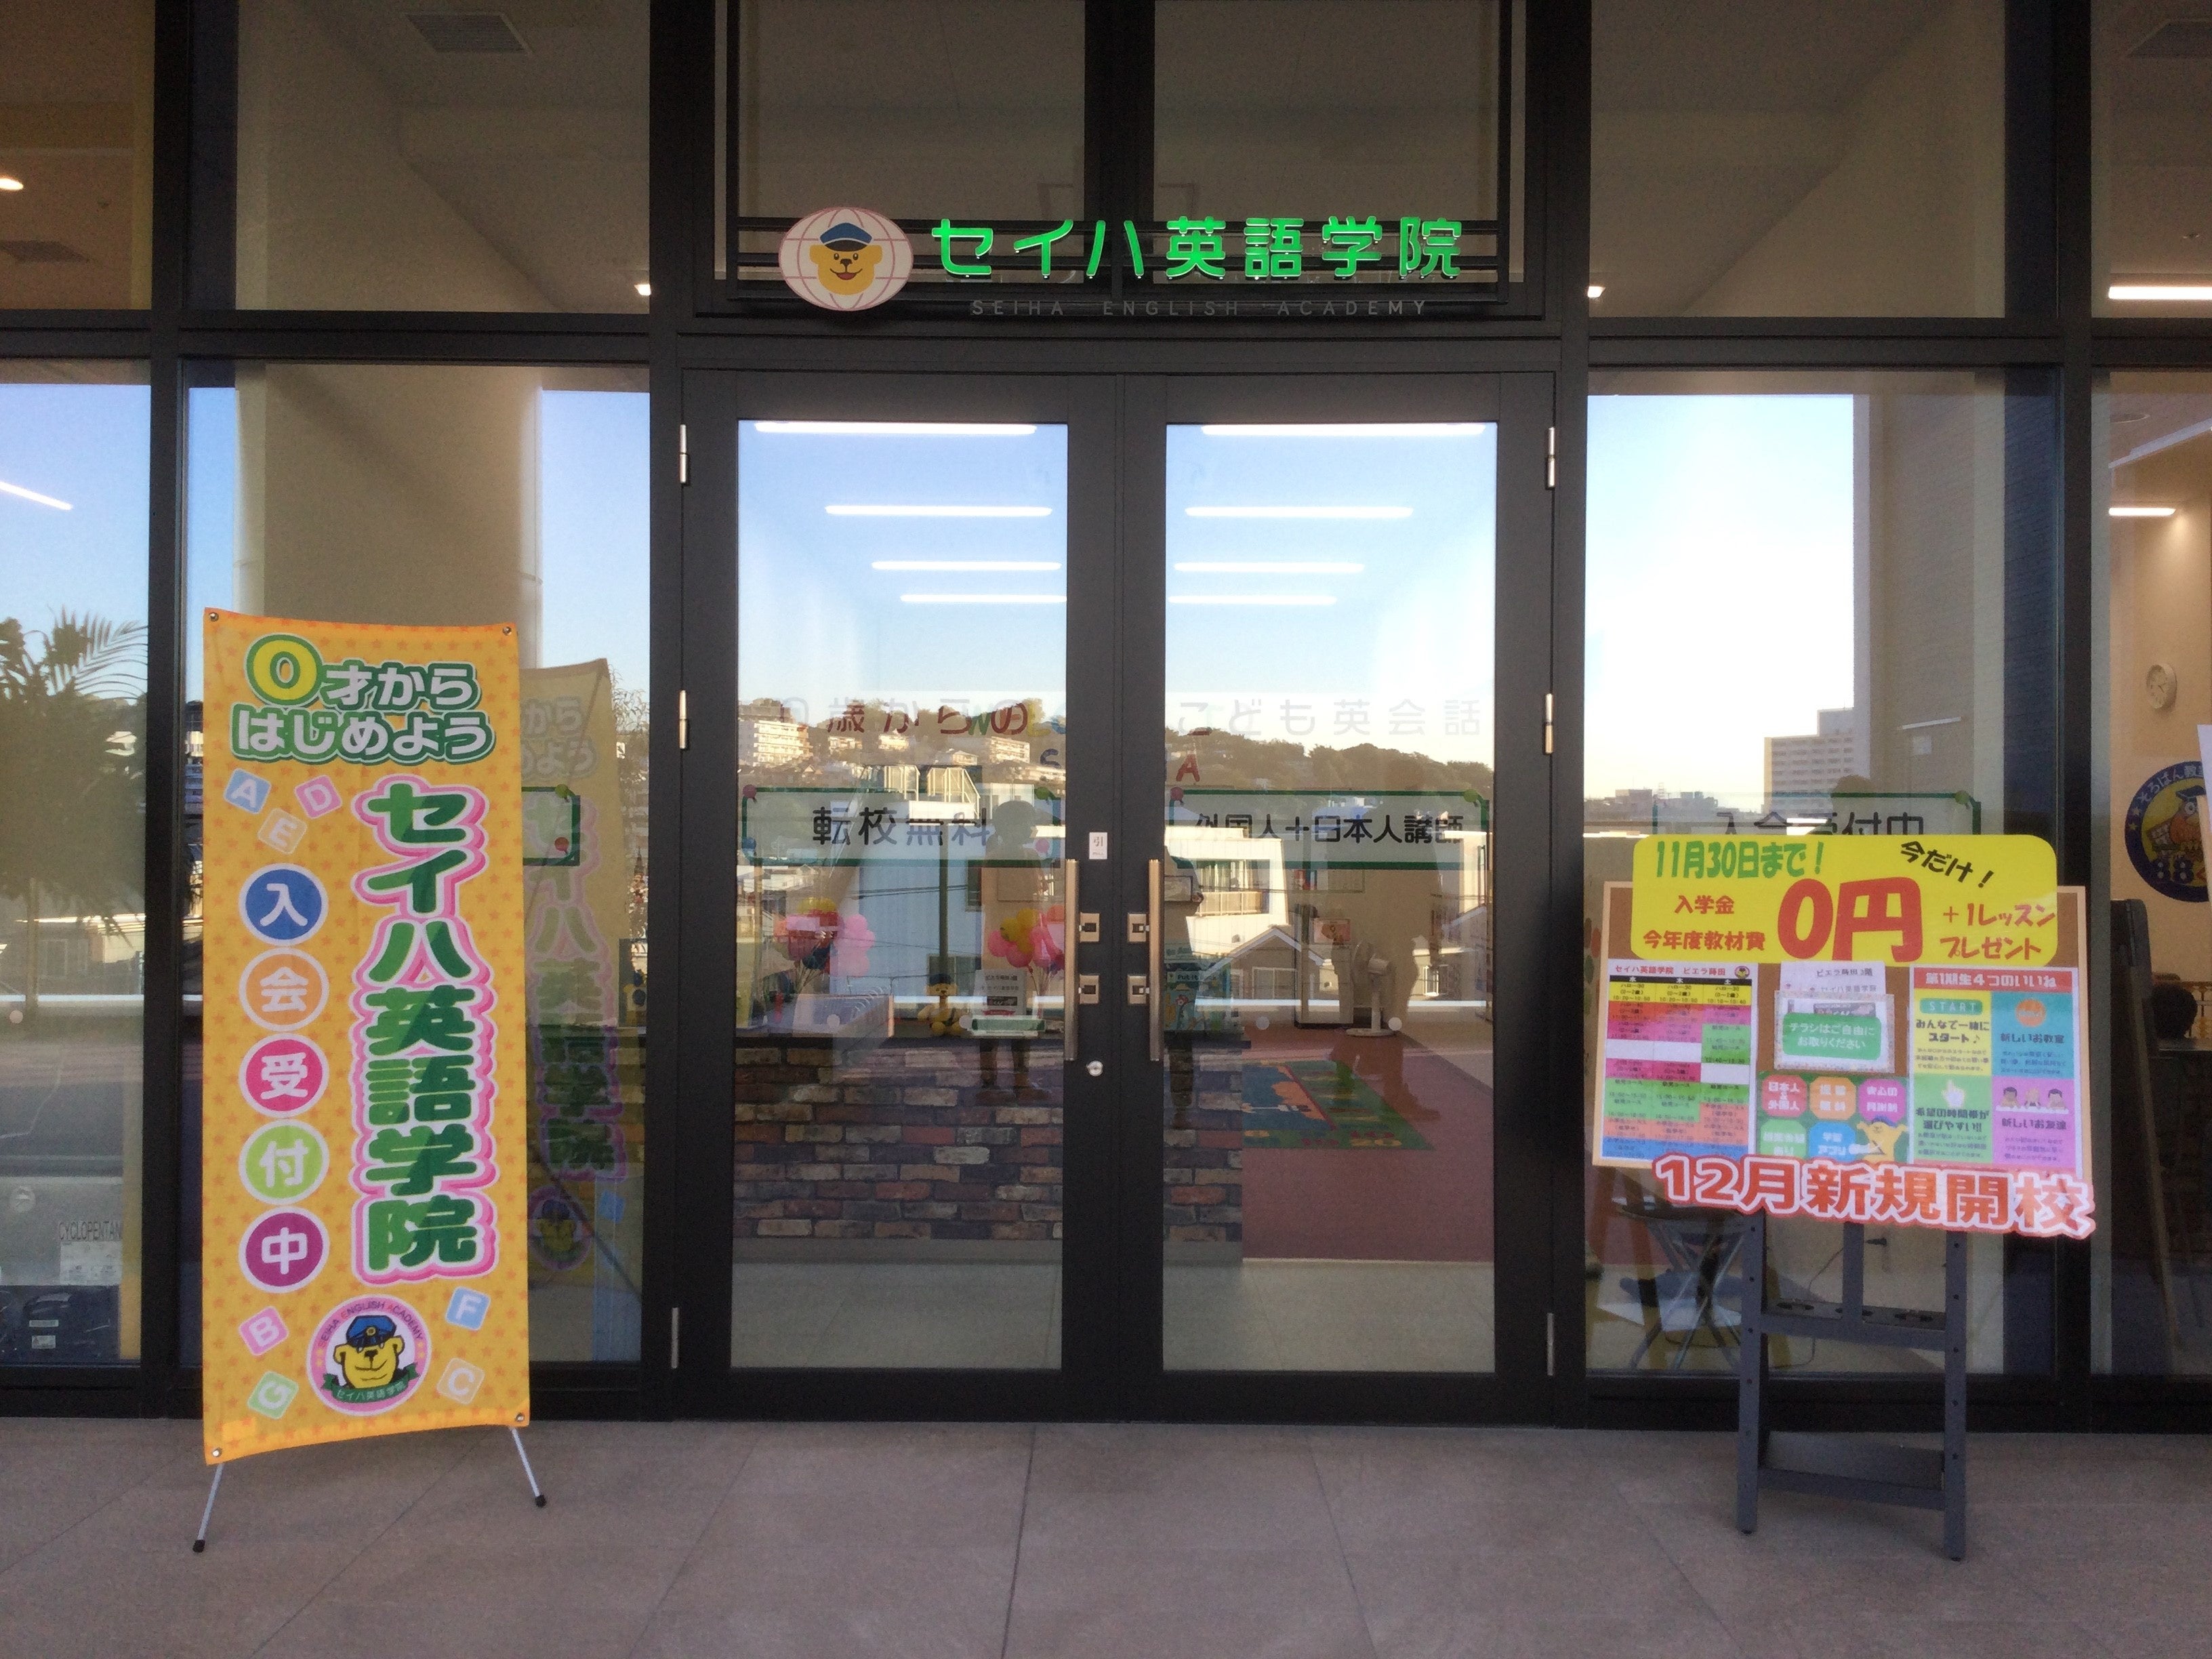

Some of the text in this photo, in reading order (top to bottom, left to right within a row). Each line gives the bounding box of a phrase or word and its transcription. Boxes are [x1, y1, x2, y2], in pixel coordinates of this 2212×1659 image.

[930, 218, 1464, 279] セイハ英語学院
[971, 300, 1427, 316] SEIHA ENGLISH ACADEMY
[247, 633, 478, 708] 0才から
[1179, 699, 1481, 736] こども英会話
[234, 708, 491, 759] はじめよう
[231, 780, 258, 807] A
[305, 785, 334, 813] D
[270, 819, 298, 850] E
[813, 806, 992, 846] 転校無料
[1674, 895, 1735, 915] 入学金
[1777, 876, 1923, 962] 0円
[1643, 929, 1766, 951] 今年度教材費
[1940, 936, 2042, 960] プレゼント
[1615, 965, 1674, 975] セイハ英語学院
[1929, 1002, 1977, 1012] START
[365, 782, 478, 1271] セイハ英語学院
[1790, 1023, 1876, 1036] チラシはご自由に
[2000, 1032, 2065, 1044] 新しいお教室
[1797, 1036, 1866, 1049] お取りください
[1656, 1155, 2093, 1235] 12月新規開校
[456, 1294, 481, 1320] F
[248, 1315, 279, 1347] B
[318, 1300, 424, 1347] SEIHA ENGLISH ACADEMY
[258, 1380, 289, 1410] G
[449, 1366, 475, 1396] C
